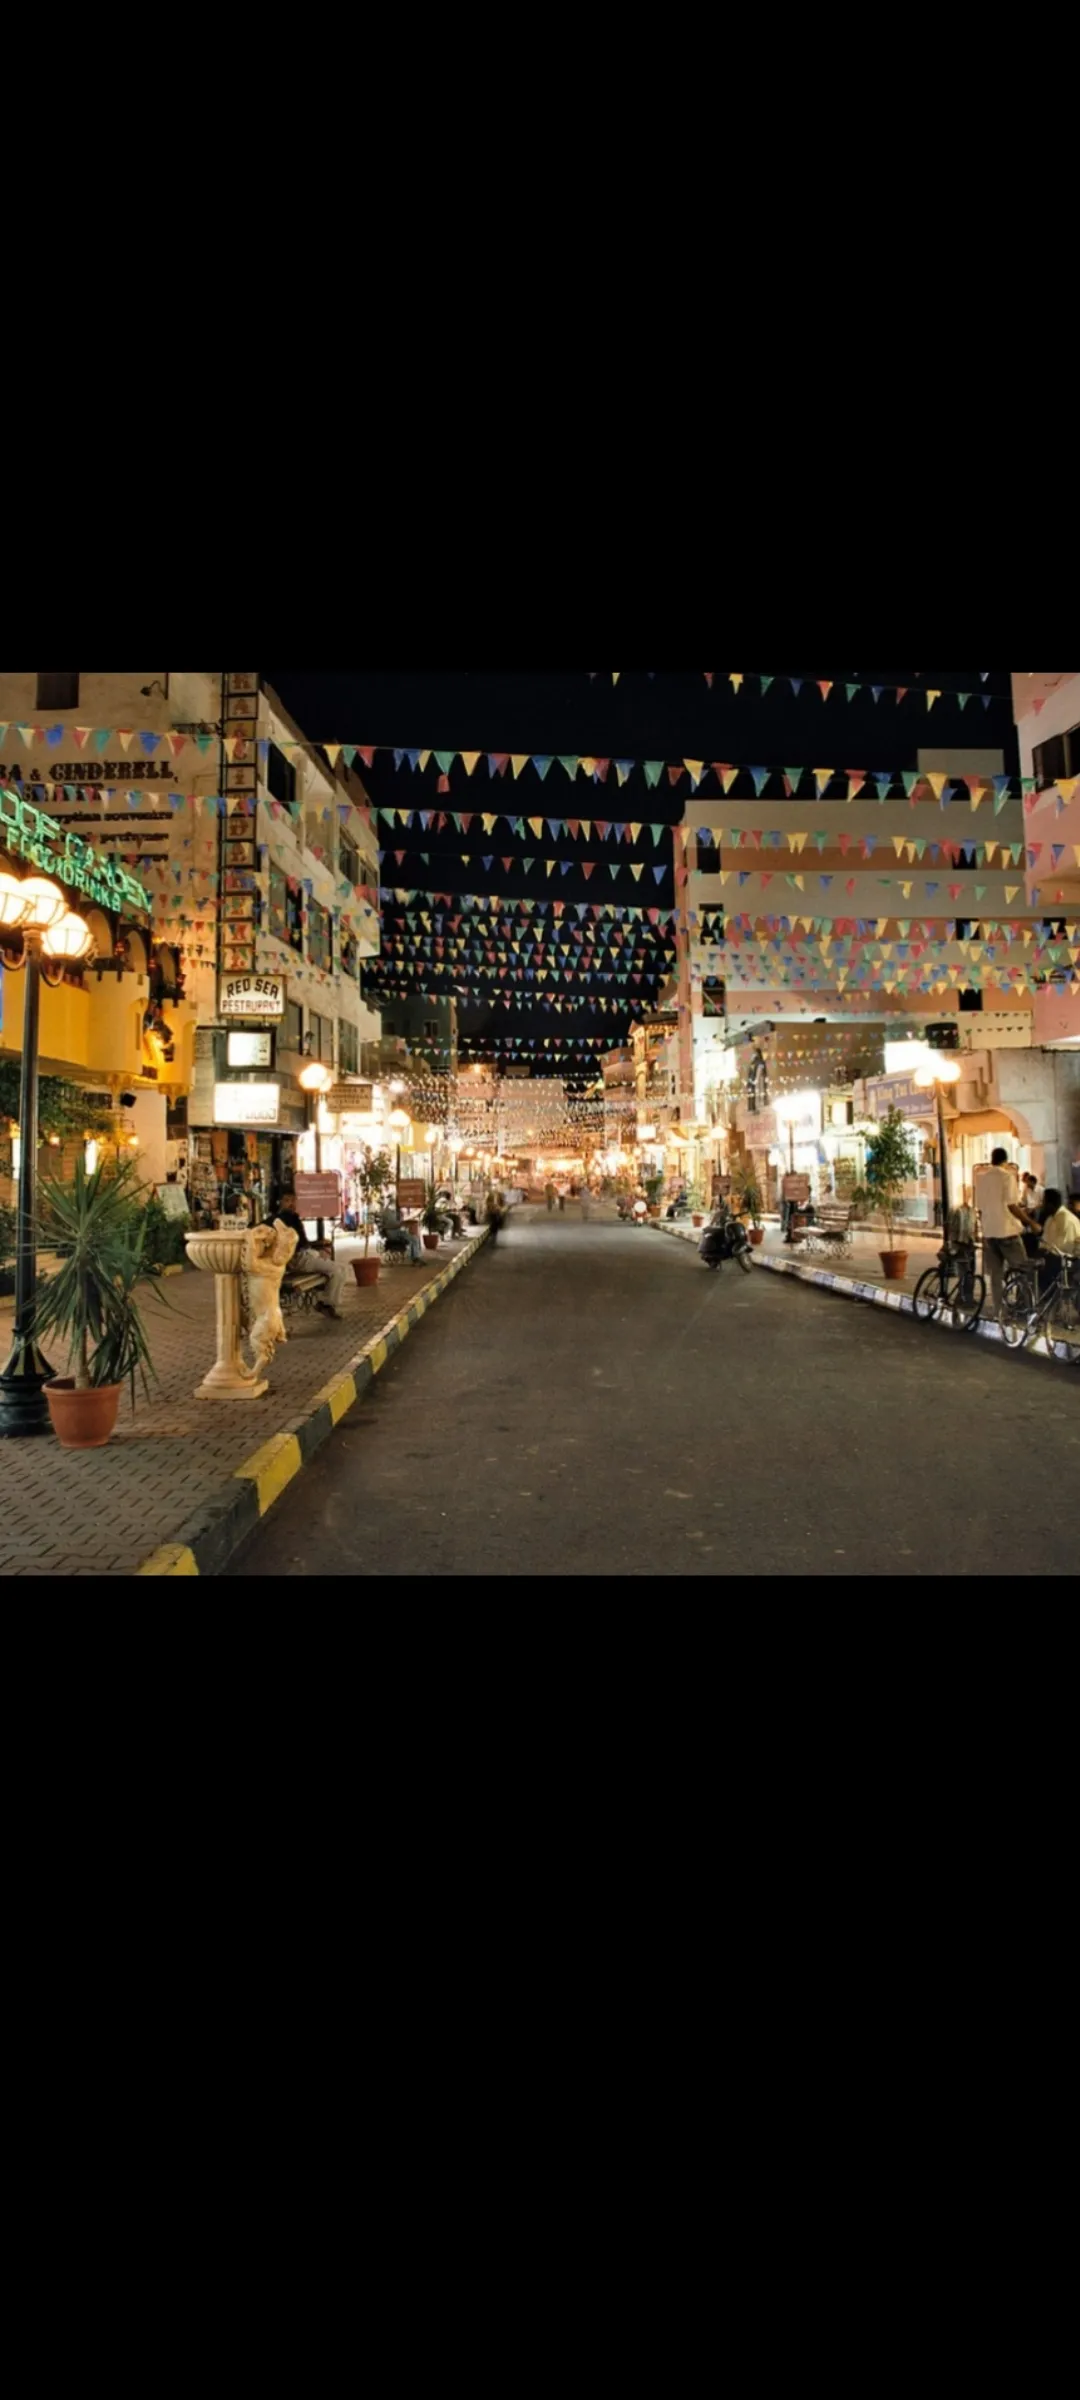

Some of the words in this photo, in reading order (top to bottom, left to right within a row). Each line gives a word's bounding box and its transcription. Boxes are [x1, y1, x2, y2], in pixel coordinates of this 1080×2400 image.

[30, 768, 41, 781] &
[227, 978, 250, 998] RED
[254, 979, 279, 999] SEA
